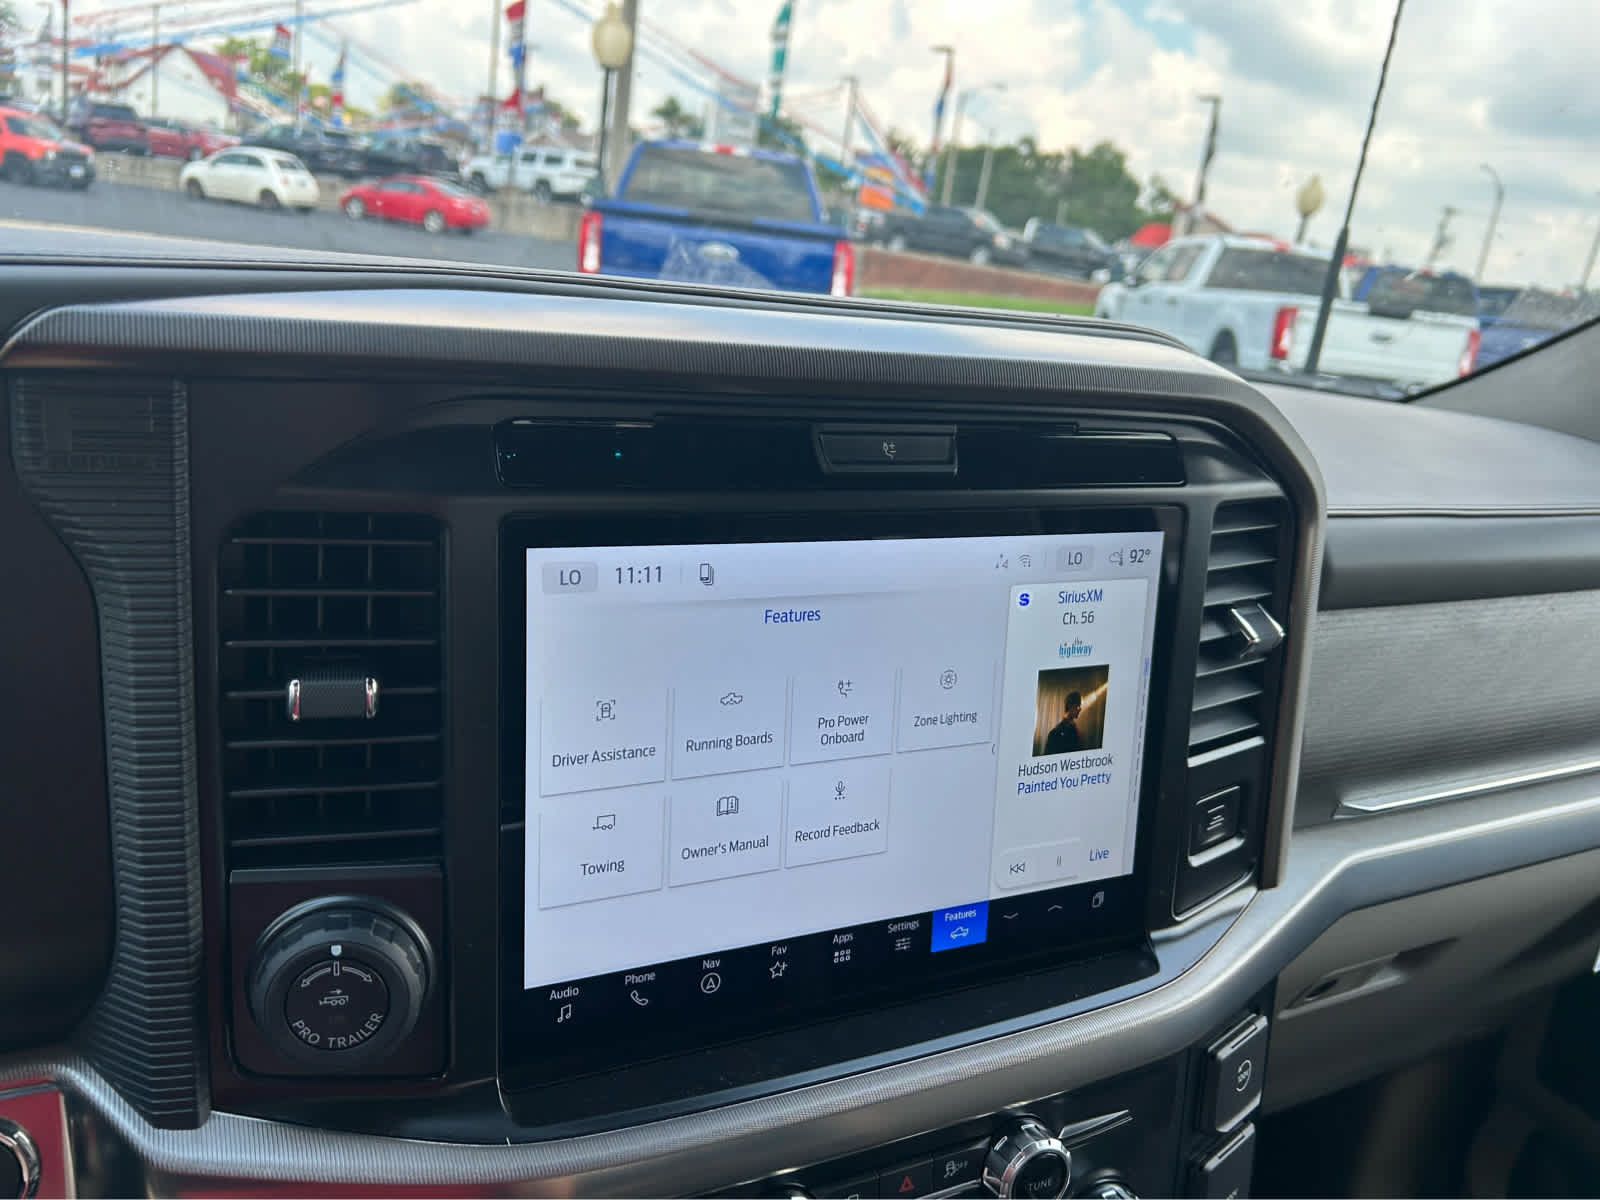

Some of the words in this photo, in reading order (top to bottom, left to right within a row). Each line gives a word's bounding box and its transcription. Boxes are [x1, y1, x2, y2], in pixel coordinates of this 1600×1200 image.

[1068, 551, 1083, 566] LO
[559, 569, 582, 586] LO
[615, 566, 663, 585] 11:11
[1057, 588, 1104, 604] SiriusXM
[763, 607, 821, 625] Features
[1062, 611, 1079, 626] Ch.
[1080, 610, 1095, 625] 56
[1058, 642, 1093, 659] highway
[817, 715, 835, 730] Pro
[837, 712, 870, 728] Power
[913, 713, 938, 729] Zone
[940, 709, 977, 727] Lighting
[685, 737, 734, 753] Running
[735, 731, 773, 747] Boards
[820, 728, 865, 746] Onboard
[551, 751, 588, 768] Driver
[591, 744, 656, 763] Assistance
[1017, 761, 1058, 778] Hudson
[1059, 753, 1114, 773] Westbrook
[1016, 778, 1057, 796] Painted
[1058, 776, 1079, 790] You
[1080, 771, 1112, 789] Pretty
[795, 825, 831, 843] Record
[832, 818, 881, 837] Feedback
[681, 842, 728, 860] Owner's
[728, 835, 770, 854] Manual
[1088, 847, 1110, 863] Live
[580, 859, 625, 877] Towing
[944, 907, 978, 923] Features
[887, 918, 920, 935] Settings
[832, 932, 854, 946] Apps
[771, 943, 788, 956] Fav
[702, 957, 721, 970] Nav
[624, 970, 656, 985] Phone
[549, 985, 580, 1000] Audio
[292, 1019, 321, 1044] PRO
[327, 1012, 383, 1049] TRAILER
[1027, 1178, 1053, 1193] TUNE
